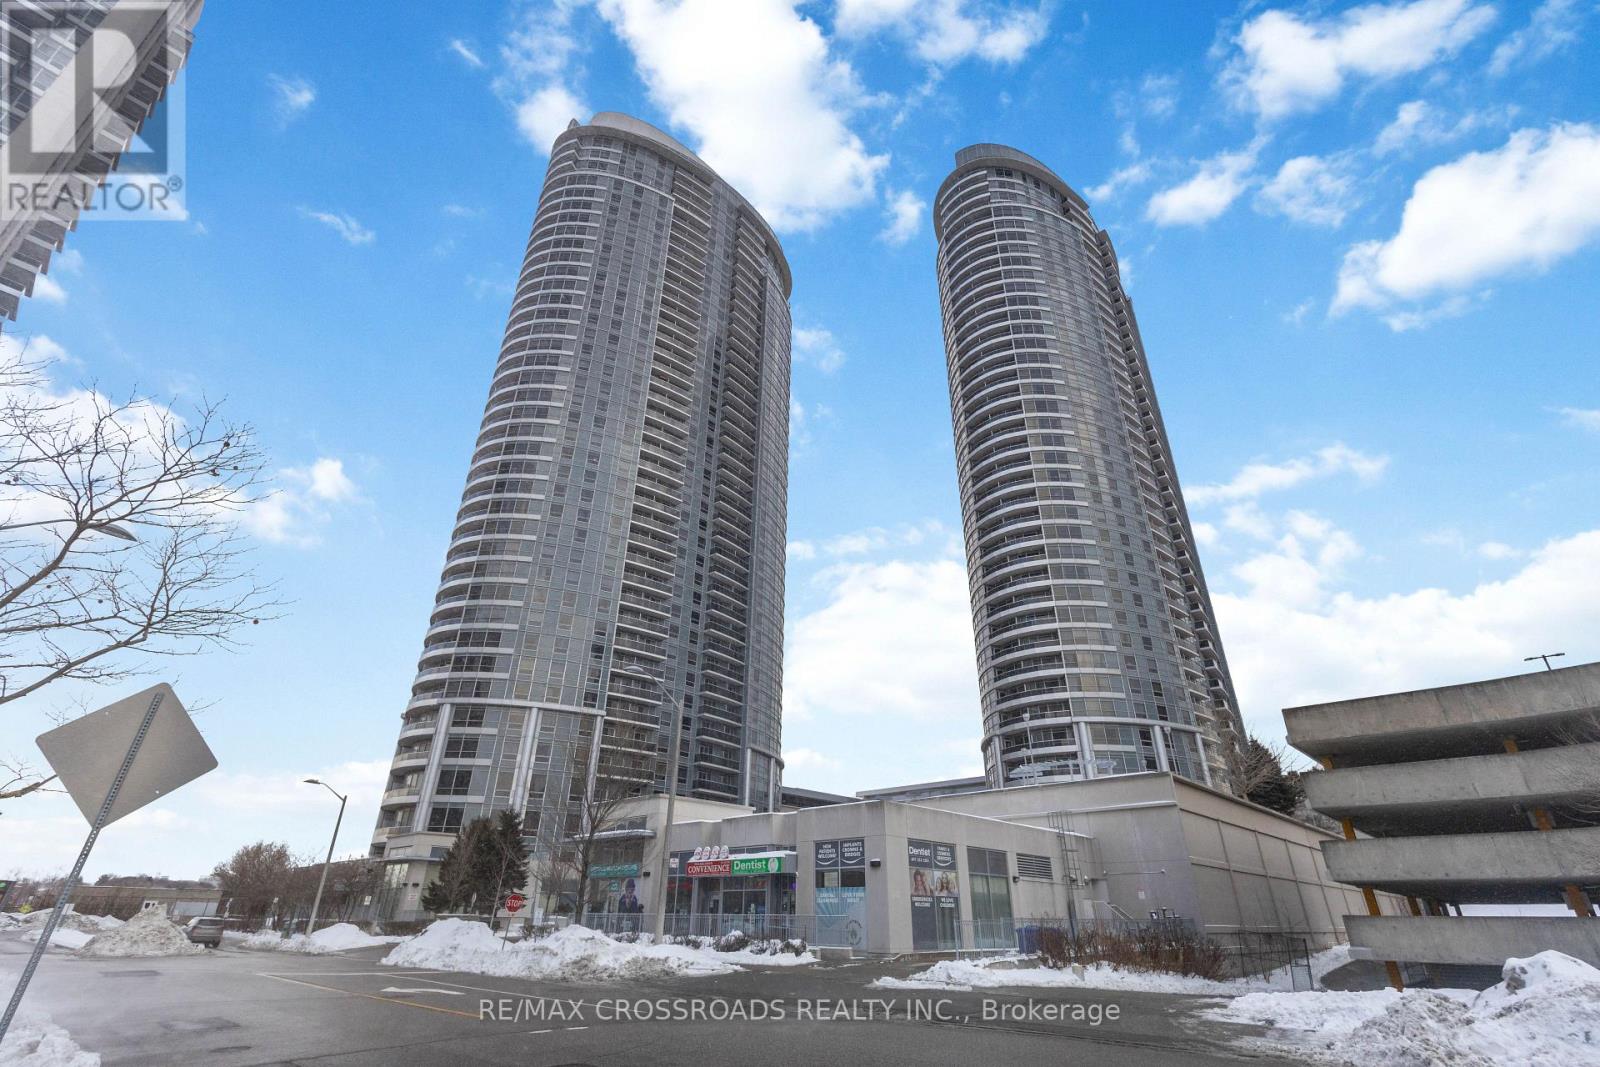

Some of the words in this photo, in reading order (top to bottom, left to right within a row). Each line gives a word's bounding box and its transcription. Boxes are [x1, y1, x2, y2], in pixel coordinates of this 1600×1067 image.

[909, 846, 931, 856] Dentist
[688, 864, 730, 873] CONVENIENCE
[734, 860, 766, 870] Dentist
[506, 899, 523, 907] STOP
